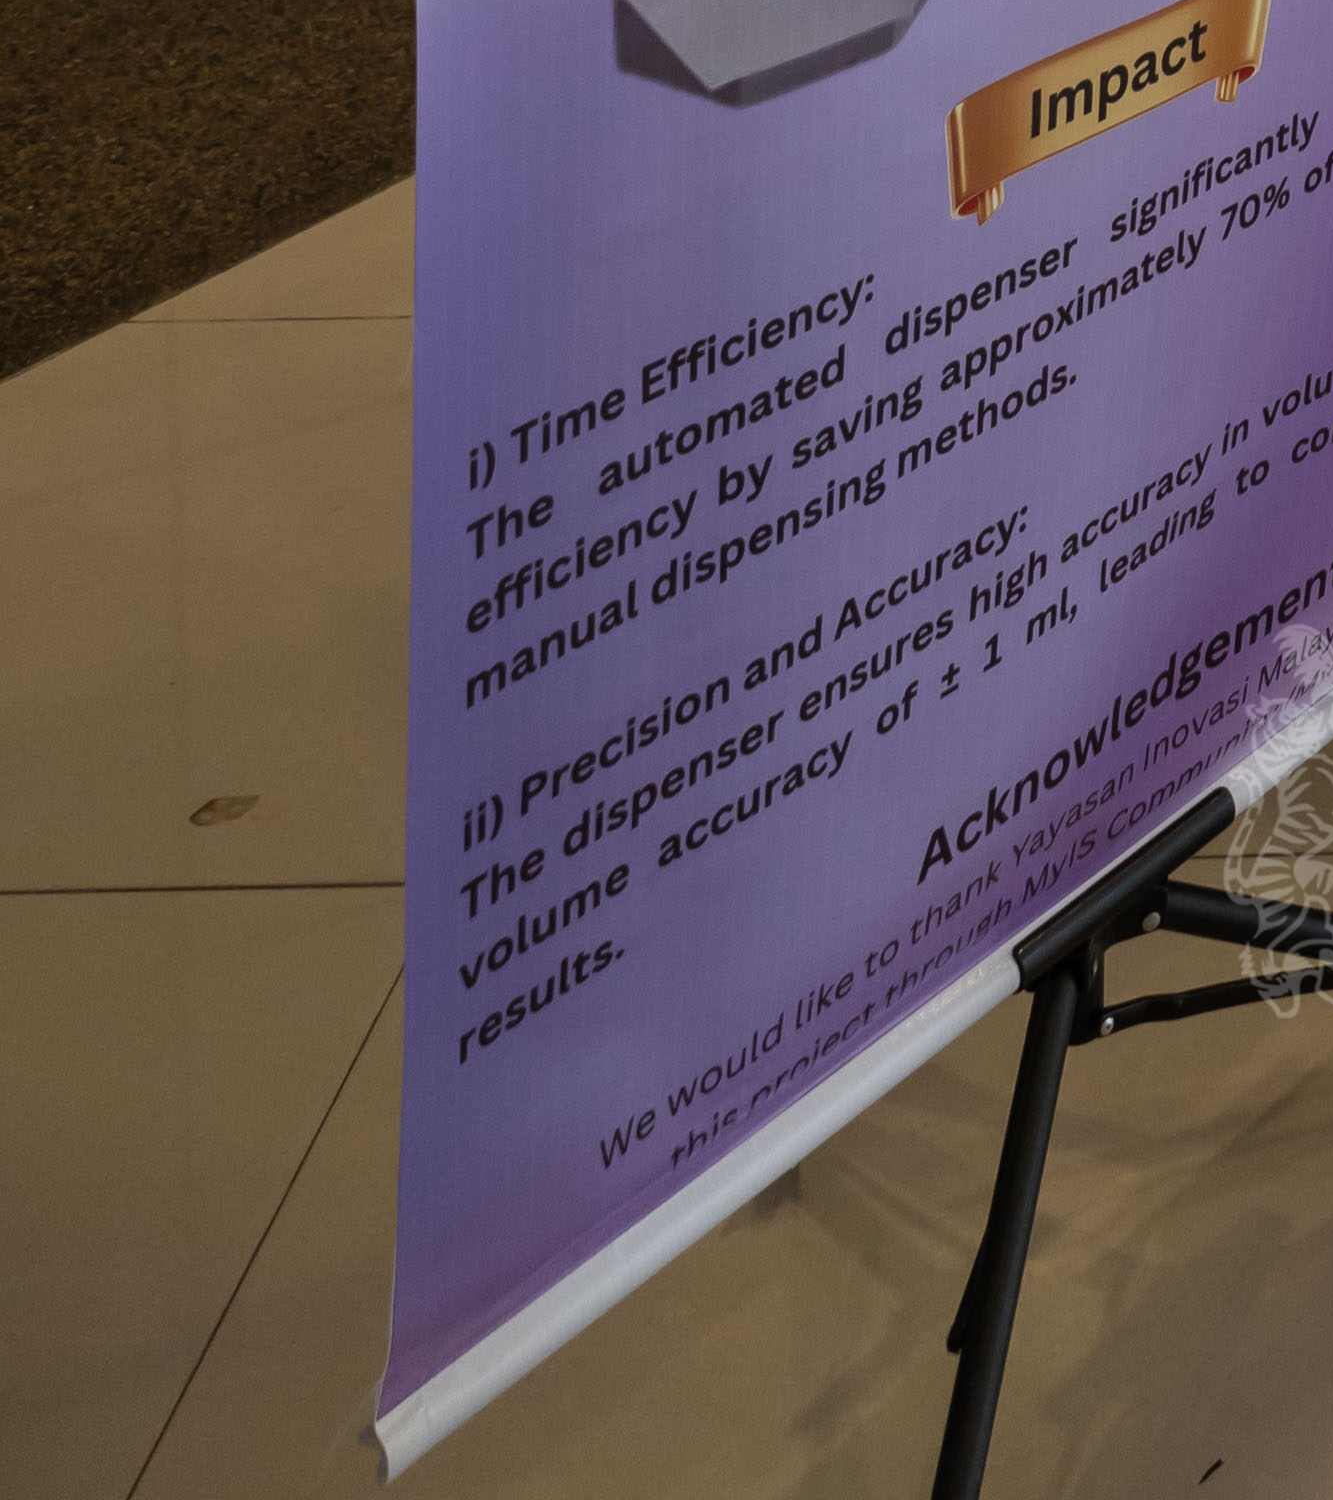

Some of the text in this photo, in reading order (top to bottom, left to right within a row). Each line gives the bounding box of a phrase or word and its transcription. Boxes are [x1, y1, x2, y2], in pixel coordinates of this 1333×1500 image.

[1028, 18, 1208, 138] Impact
[468, 496, 552, 558] The
[600, 345, 844, 494] automated
[886, 239, 1077, 354] dispenser
[1111, 112, 1318, 241] significantly
[468, 491, 696, 632] efficiency
[720, 456, 771, 504] by
[793, 377, 921, 467] saving
[941, 228, 1205, 390] approximately
[1222, 178, 1289, 239] 70%
[471, 275, 873, 489] i) Time Efficiency:
[461, 850, 543, 917] The
[564, 712, 783, 855] dispenser
[800, 611, 952, 720] ensures
[971, 552, 1046, 620] high
[1062, 445, 1211, 562] accuracy
[1223, 420, 1248, 454] in
[465, 507, 1027, 850] ii) Precision and Accuracy:
[467, 366, 1075, 708] manual dispensing methods.
[460, 865, 628, 988] volume
[659, 732, 851, 866] accuracy
[877, 681, 917, 734] of
[1027, 588, 1076, 643] ml,
[1101, 490, 1215, 591] leading
[1237, 461, 1268, 494] to
[461, 942, 623, 1063] results.
